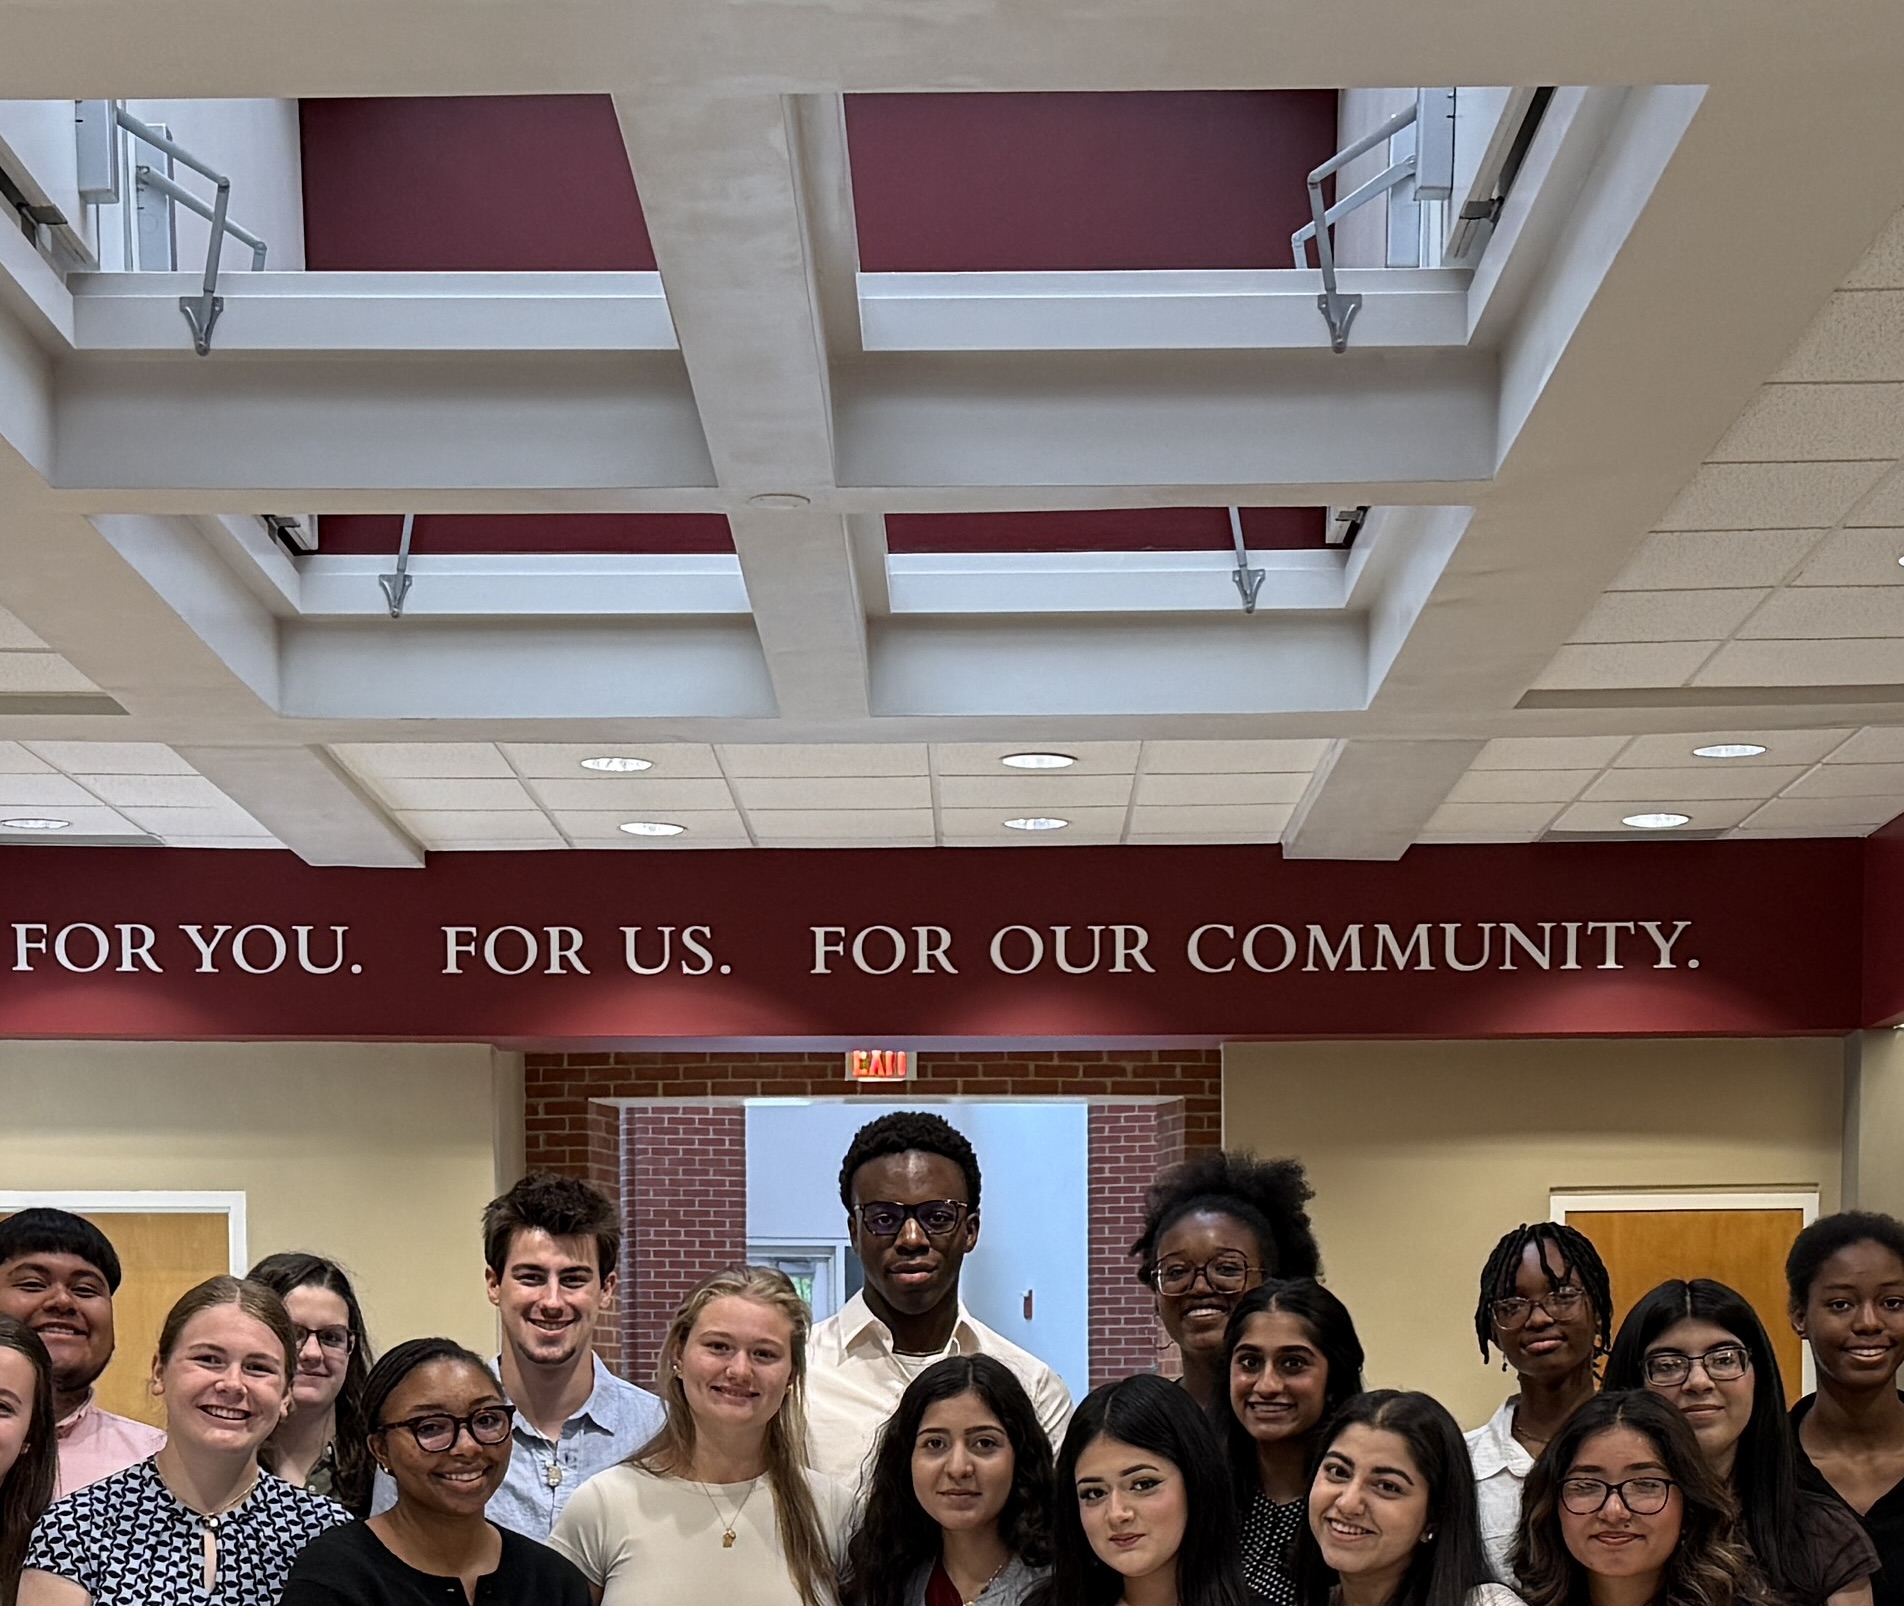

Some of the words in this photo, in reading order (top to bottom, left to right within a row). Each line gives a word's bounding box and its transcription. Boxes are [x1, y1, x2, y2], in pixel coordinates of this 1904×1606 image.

[11, 922, 163, 973] FOR
[178, 924, 362, 974] YOU.
[440, 925, 591, 975] FOR
[619, 925, 731, 975] US.
[809, 925, 959, 975] FOR
[990, 925, 1156, 974] OUR
[1187, 920, 1700, 973] COMMUNITY.
